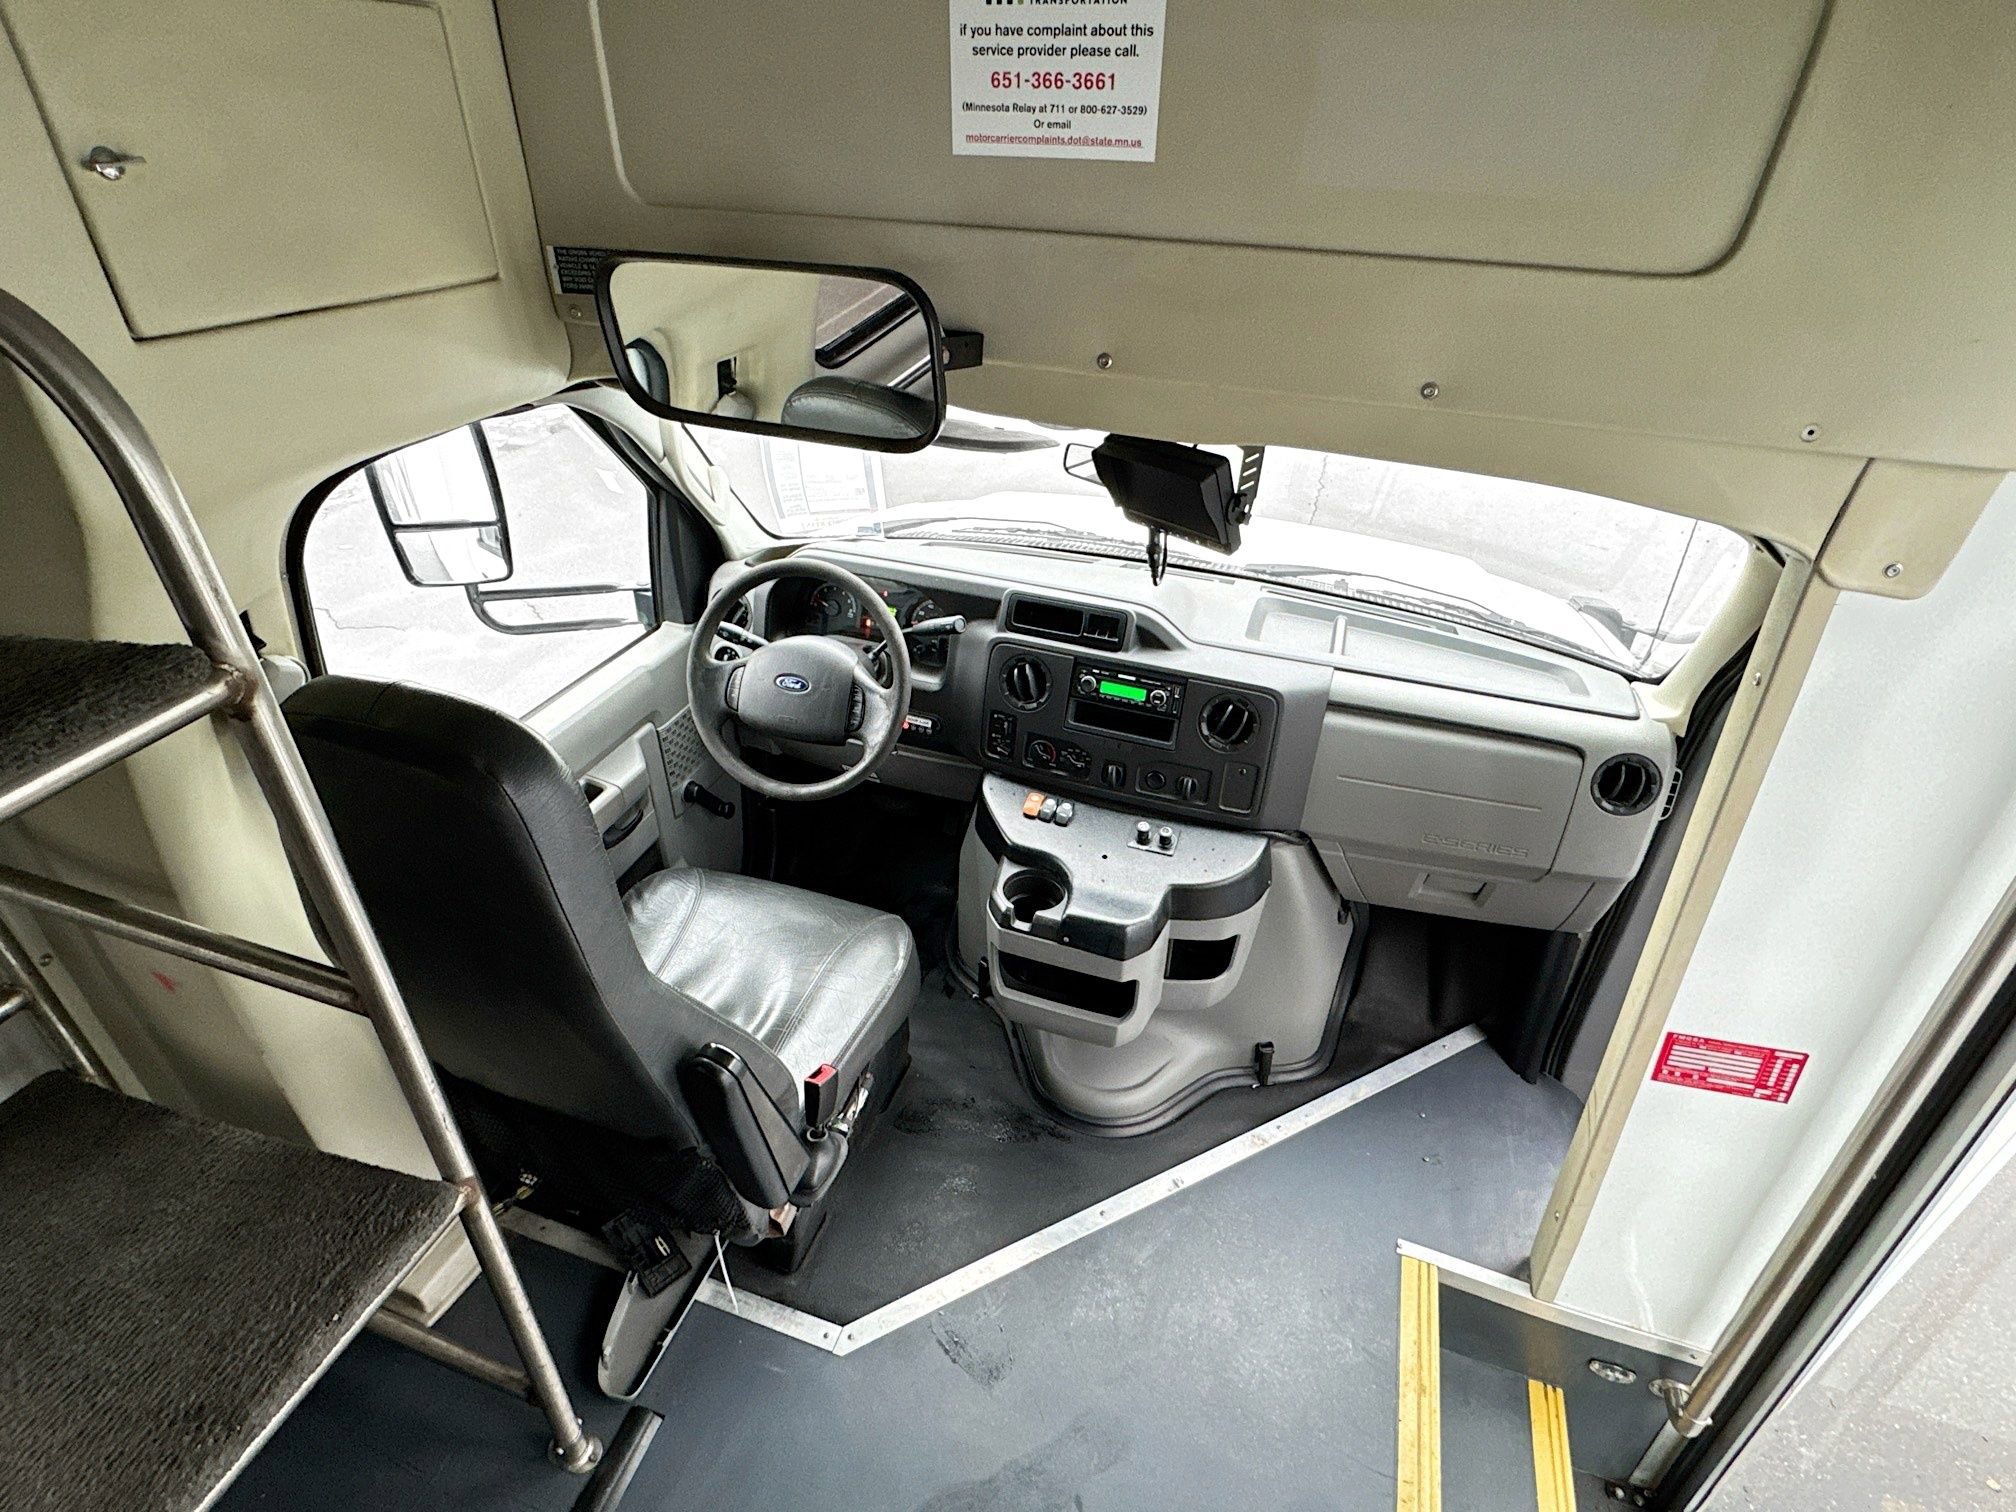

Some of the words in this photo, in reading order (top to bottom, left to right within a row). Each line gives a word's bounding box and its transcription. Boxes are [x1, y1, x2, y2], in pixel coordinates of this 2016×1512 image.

[960, 23, 967, 36] if
[970, 26, 991, 39] you
[995, 23, 1023, 36] have
[1027, 23, 1087, 39] complaint
[1090, 24, 1127, 37] about
[1131, 24, 1154, 37] this
[972, 43, 1013, 56] service
[1017, 44, 1067, 59] provider
[1070, 44, 1111, 59] please
[1115, 44, 1139, 57] call.
[991, 71, 1115, 91] 651-366-3661
[962, 101, 1010, 113] (Minnesota
[1013, 102, 1036, 115] Relay
[1039, 104, 1048, 114] at
[1050, 104, 1065, 114] 711
[1068, 106, 1078, 114] or
[1080, 104, 1148, 117] 800-627-3529)
[1033, 118, 1044, 129] Or
[1047, 119, 1071, 130] email
[965, 133, 1143, 148] motorcarriercomplaints.dot@state.mn.us
